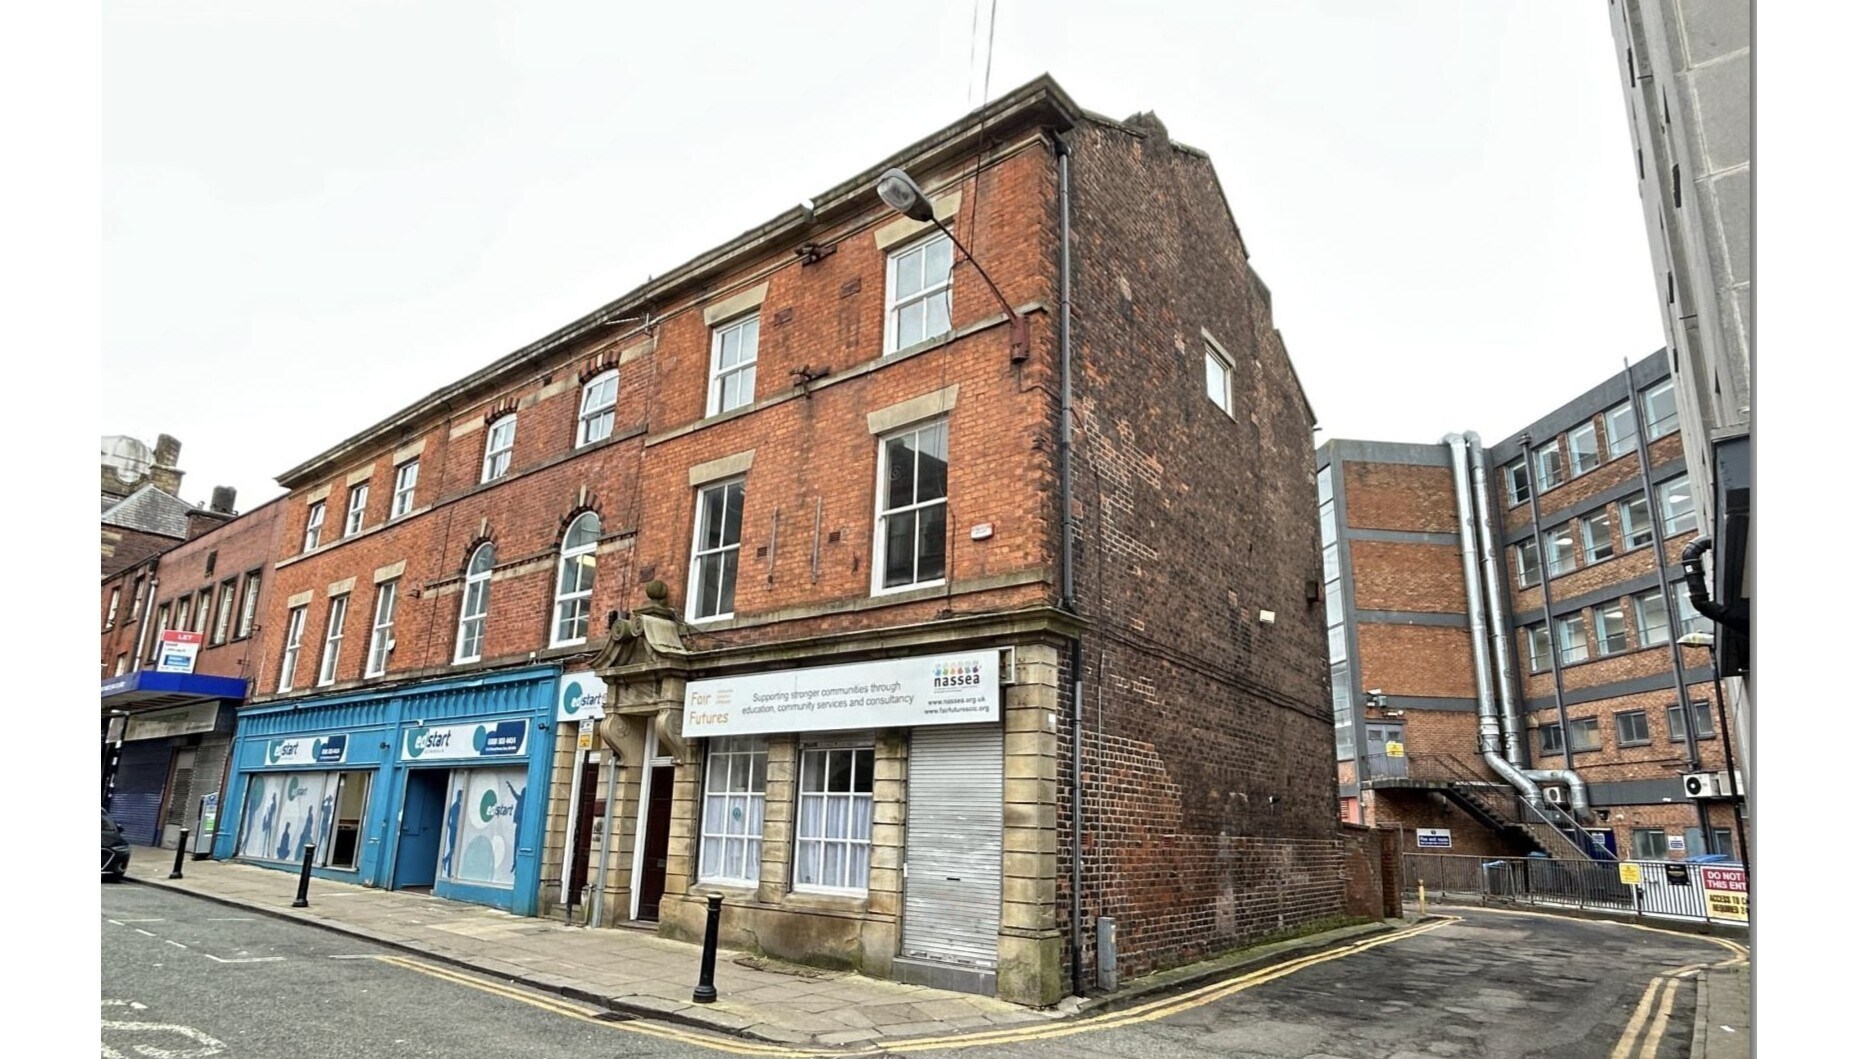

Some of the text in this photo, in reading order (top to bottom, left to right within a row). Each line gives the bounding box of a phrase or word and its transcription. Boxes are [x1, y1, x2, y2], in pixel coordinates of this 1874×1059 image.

[934, 674, 980, 687] nassea
[753, 681, 901, 703] Supporting stronger communities through
[691, 692, 711, 706] Fair
[742, 695, 914, 715] education, community services and consultancy
[928, 696, 985, 705] www.nassea.org.uk
[689, 711, 729, 725] Futures
[414, 730, 451, 749] edstart
[1707, 871, 1721, 880] DO
[1722, 872, 1741, 881] NOT
[1706, 880, 1729, 889] THIS
[1710, 895, 1731, 903] ACCESS
[1732, 896, 1740, 904] TO
